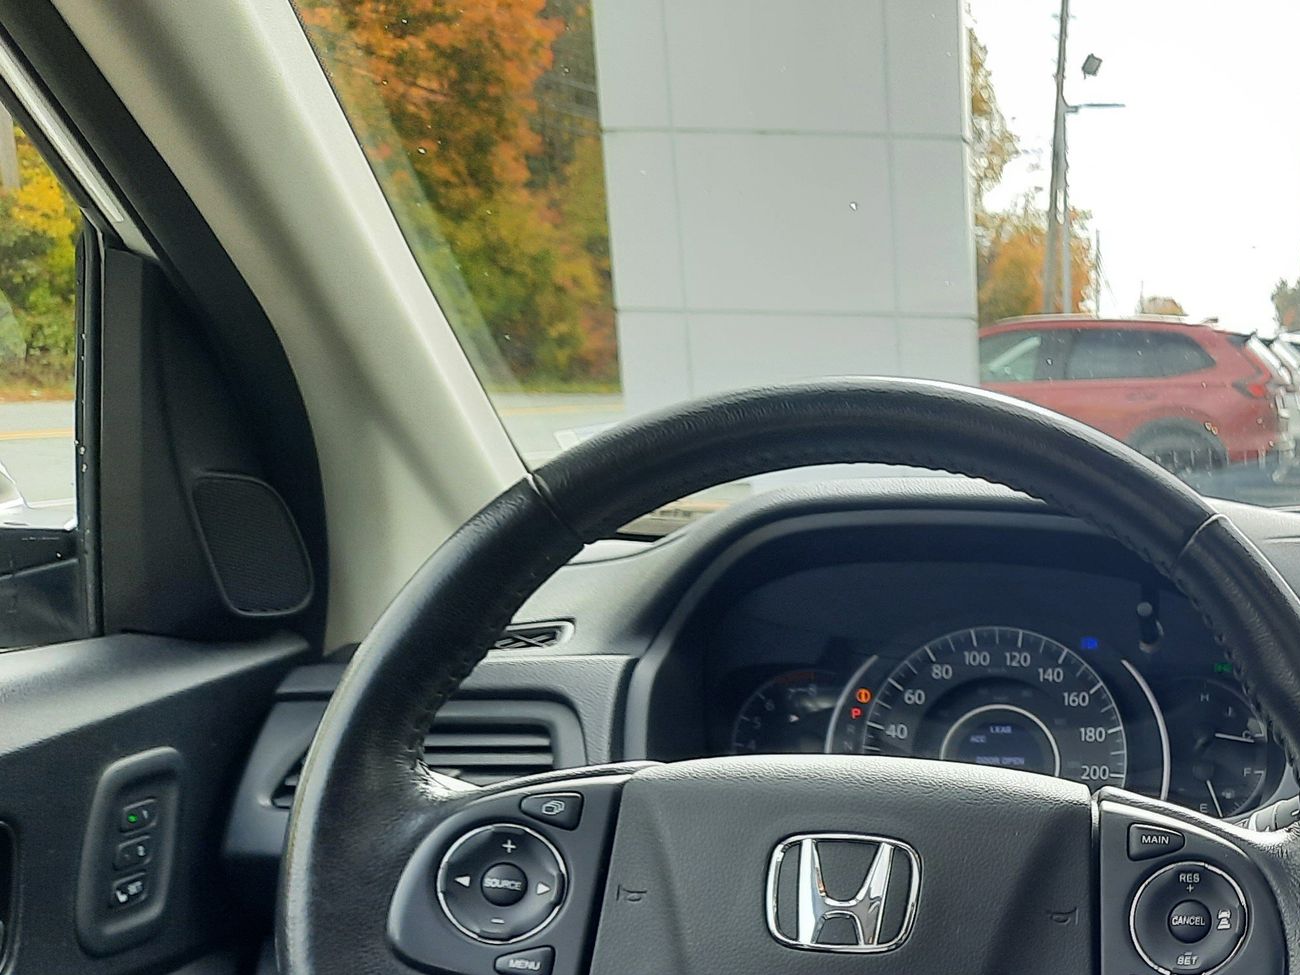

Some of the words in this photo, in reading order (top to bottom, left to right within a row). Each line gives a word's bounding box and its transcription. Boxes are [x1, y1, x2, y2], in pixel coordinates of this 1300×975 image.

[964, 652, 991, 666] 100
[1005, 652, 1031, 667] 120
[932, 664, 953, 679] 80
[1038, 668, 1064, 682] 140
[904, 690, 926, 705] 60
[1063, 692, 1090, 707] 160
[851, 707, 862, 719] P
[885, 724, 909, 740] 40
[1079, 727, 1106, 742] 180
[1081, 765, 1110, 780] 200
[1141, 835, 1169, 844] MAIN
[483, 877, 522, 891] SOURCE
[1179, 873, 1200, 883] RES
[1171, 915, 1206, 926] CANCEL
[508, 959, 541, 971] MENU
[1176, 955, 1199, 965] SET
